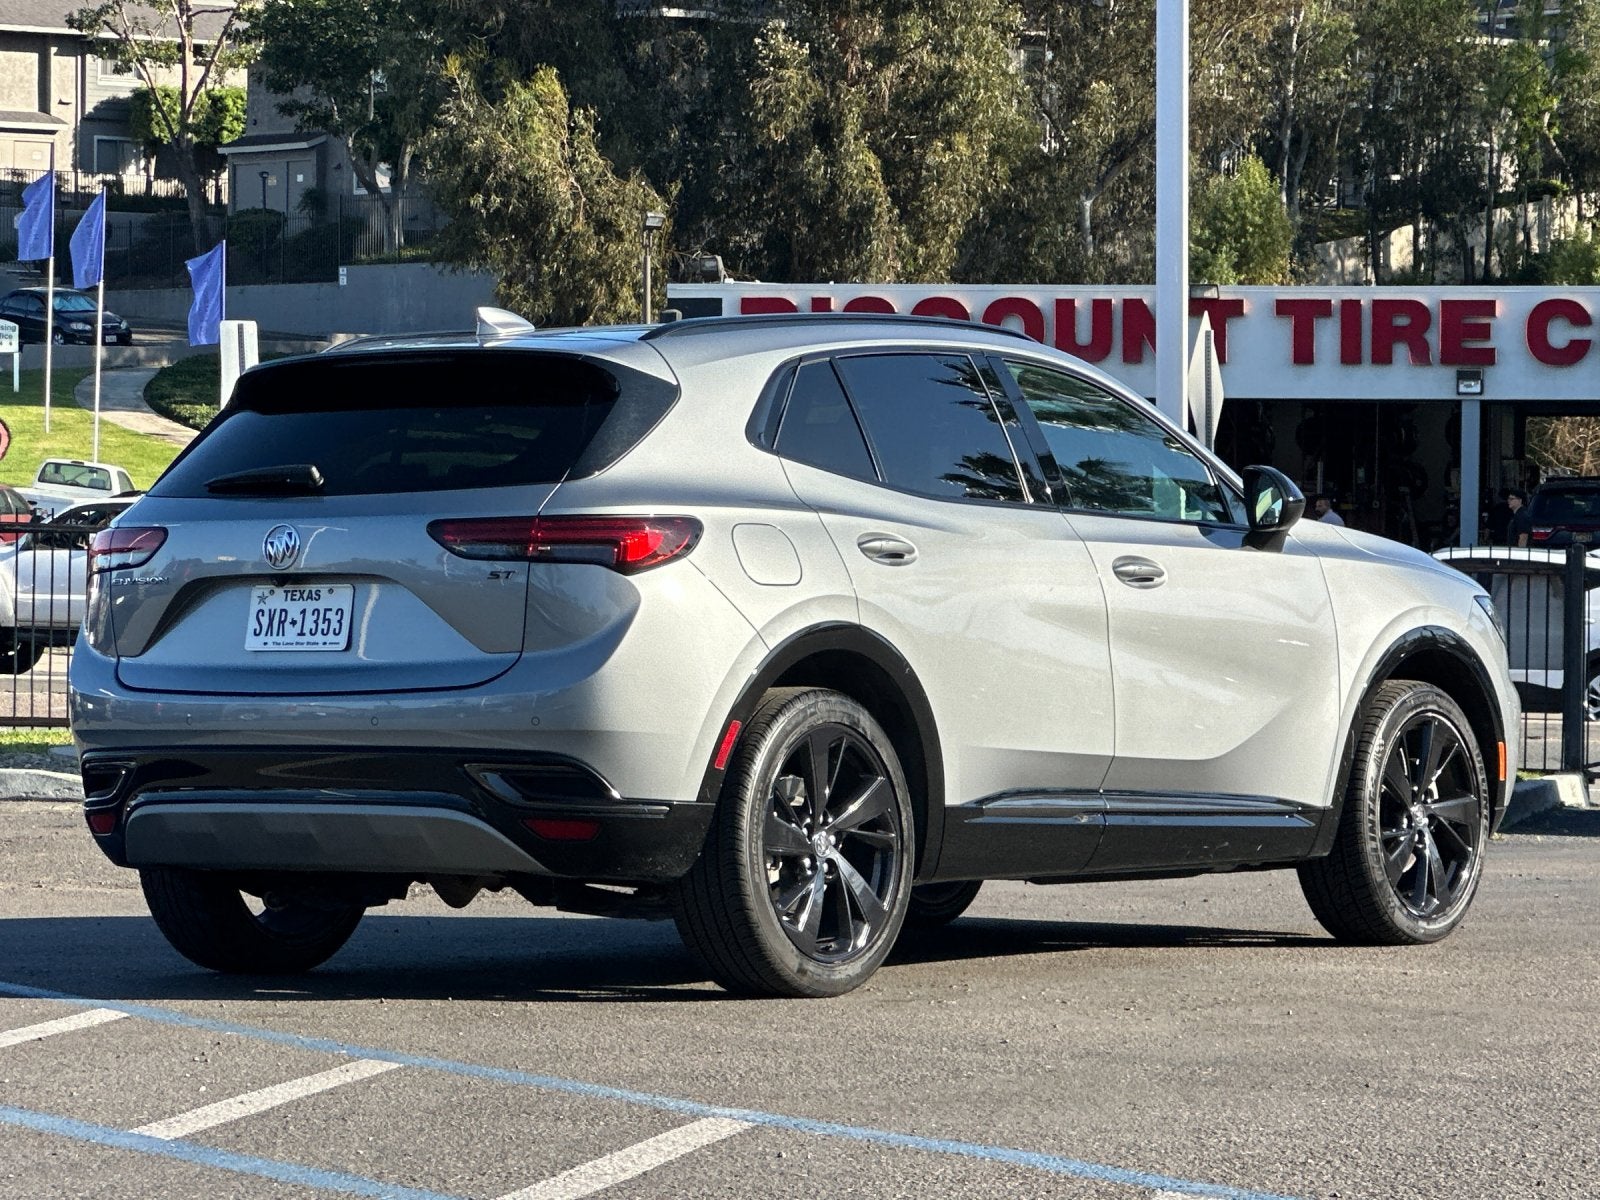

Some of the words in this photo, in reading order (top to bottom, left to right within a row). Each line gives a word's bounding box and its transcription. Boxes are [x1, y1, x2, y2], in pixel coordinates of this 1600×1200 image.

[1275, 299, 1497, 365] TIRE
[487, 570, 516, 579] ST
[283, 590, 321, 601] TEXAS
